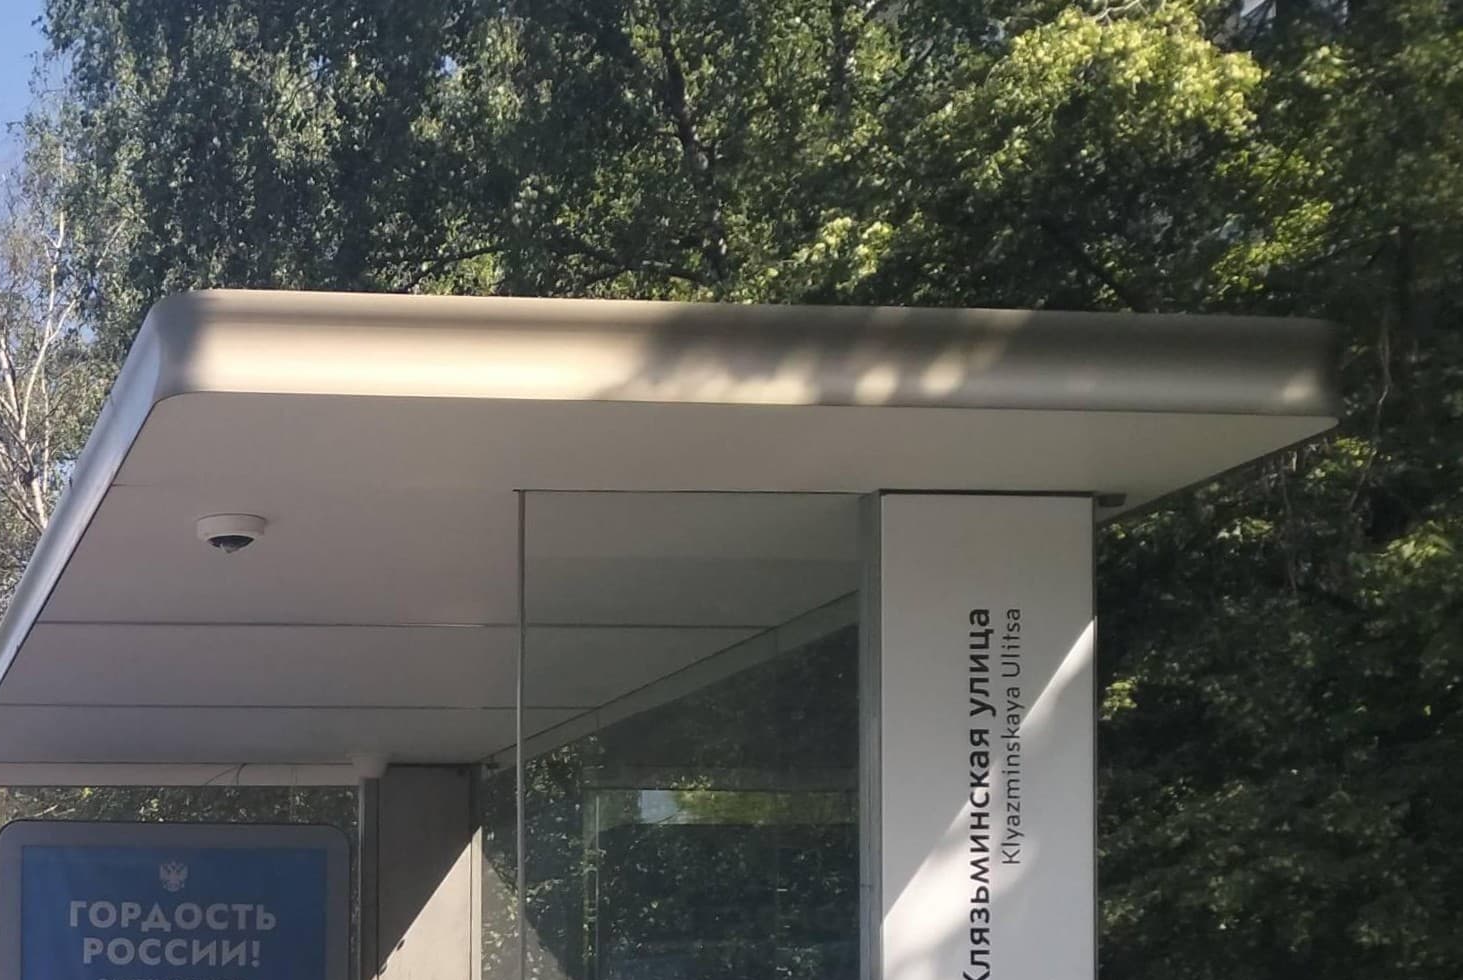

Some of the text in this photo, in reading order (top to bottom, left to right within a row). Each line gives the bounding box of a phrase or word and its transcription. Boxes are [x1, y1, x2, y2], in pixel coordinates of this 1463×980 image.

[969, 608, 996, 717] улица
[1001, 608, 1026, 865] Klyazminskaya Ulitsa
[70, 901, 276, 932] ГОРДОСТЬ
[83, 937, 260, 967] РОССИИ!
